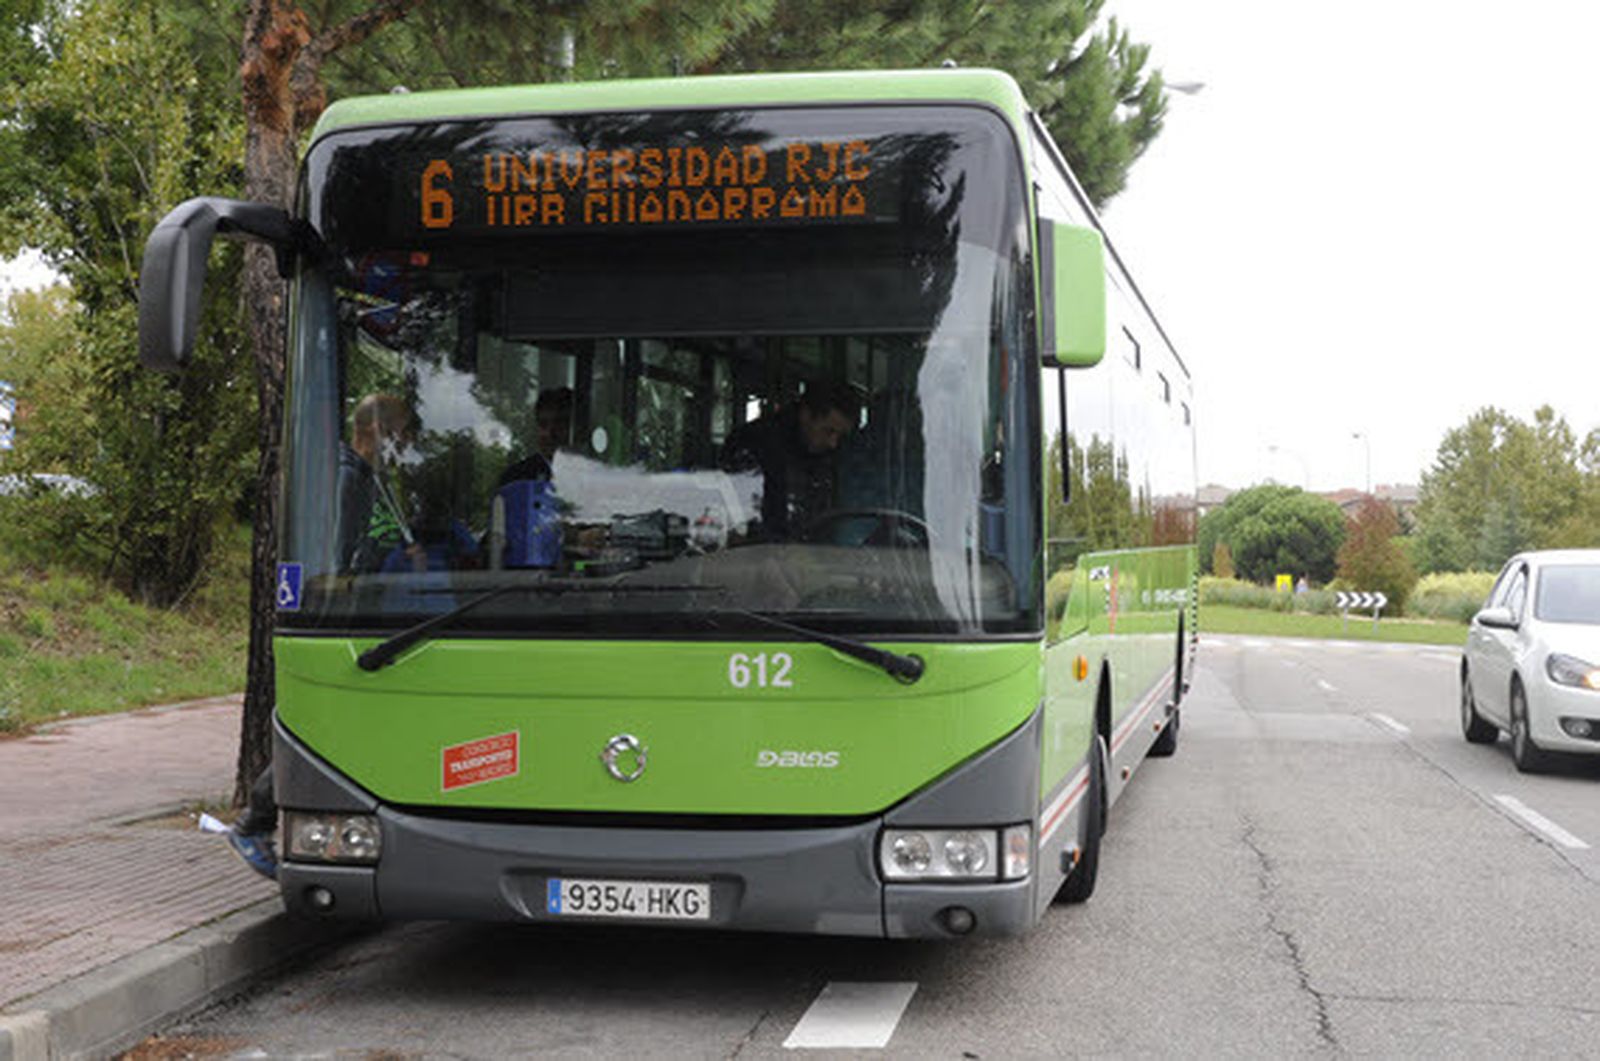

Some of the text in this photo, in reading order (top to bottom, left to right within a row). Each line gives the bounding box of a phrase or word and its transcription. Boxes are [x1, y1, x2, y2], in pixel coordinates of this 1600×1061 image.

[483, 139, 871, 192] UNIVERSIDAD RJC
[421, 159, 454, 229] 6
[728, 652, 793, 688] 612
[569, 883, 701, 916] 9354 HKG
